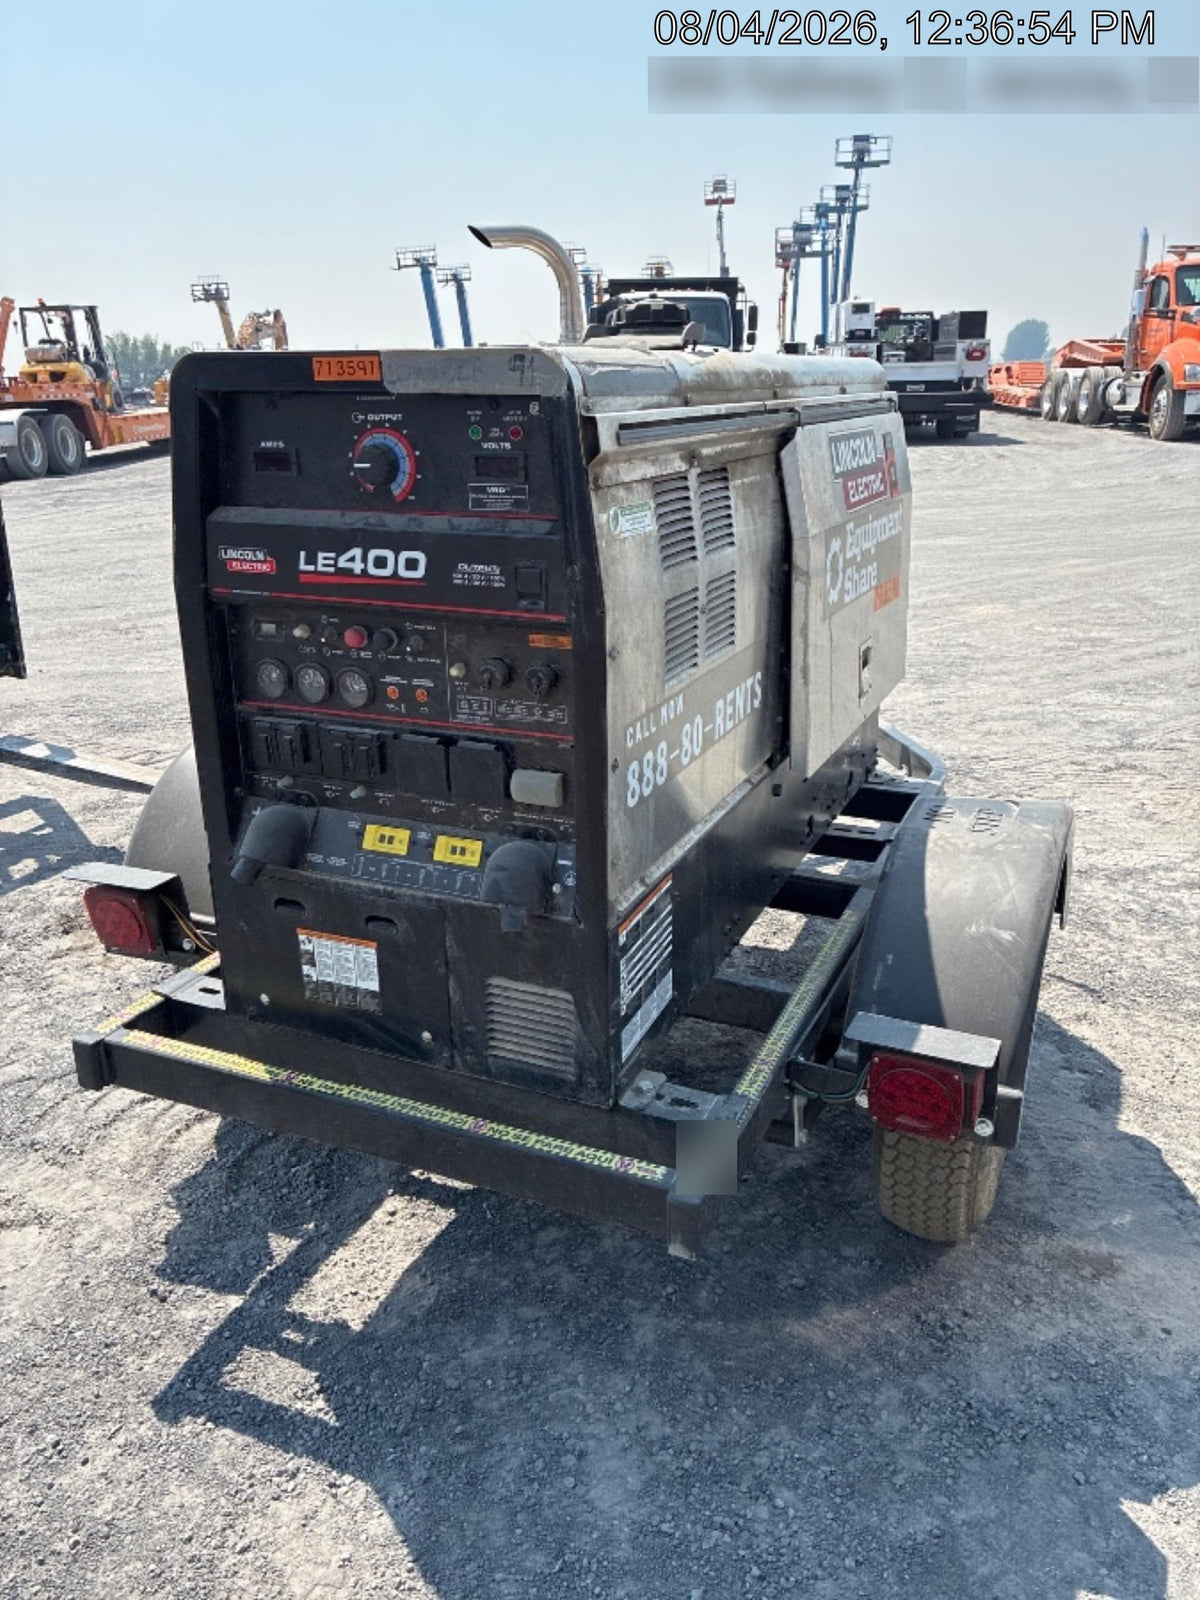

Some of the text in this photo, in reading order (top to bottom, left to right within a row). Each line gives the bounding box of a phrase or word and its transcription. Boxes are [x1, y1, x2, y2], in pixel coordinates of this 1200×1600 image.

[367, 413, 403, 421] OUTPUT
[481, 442, 512, 450] VOLTS
[221, 549, 265, 561] LINCOLN
[298, 546, 427, 579] LE400
[843, 561, 878, 605] Share
[626, 711, 657, 749] CALL
[626, 671, 762, 808] 888-80-RENTS
